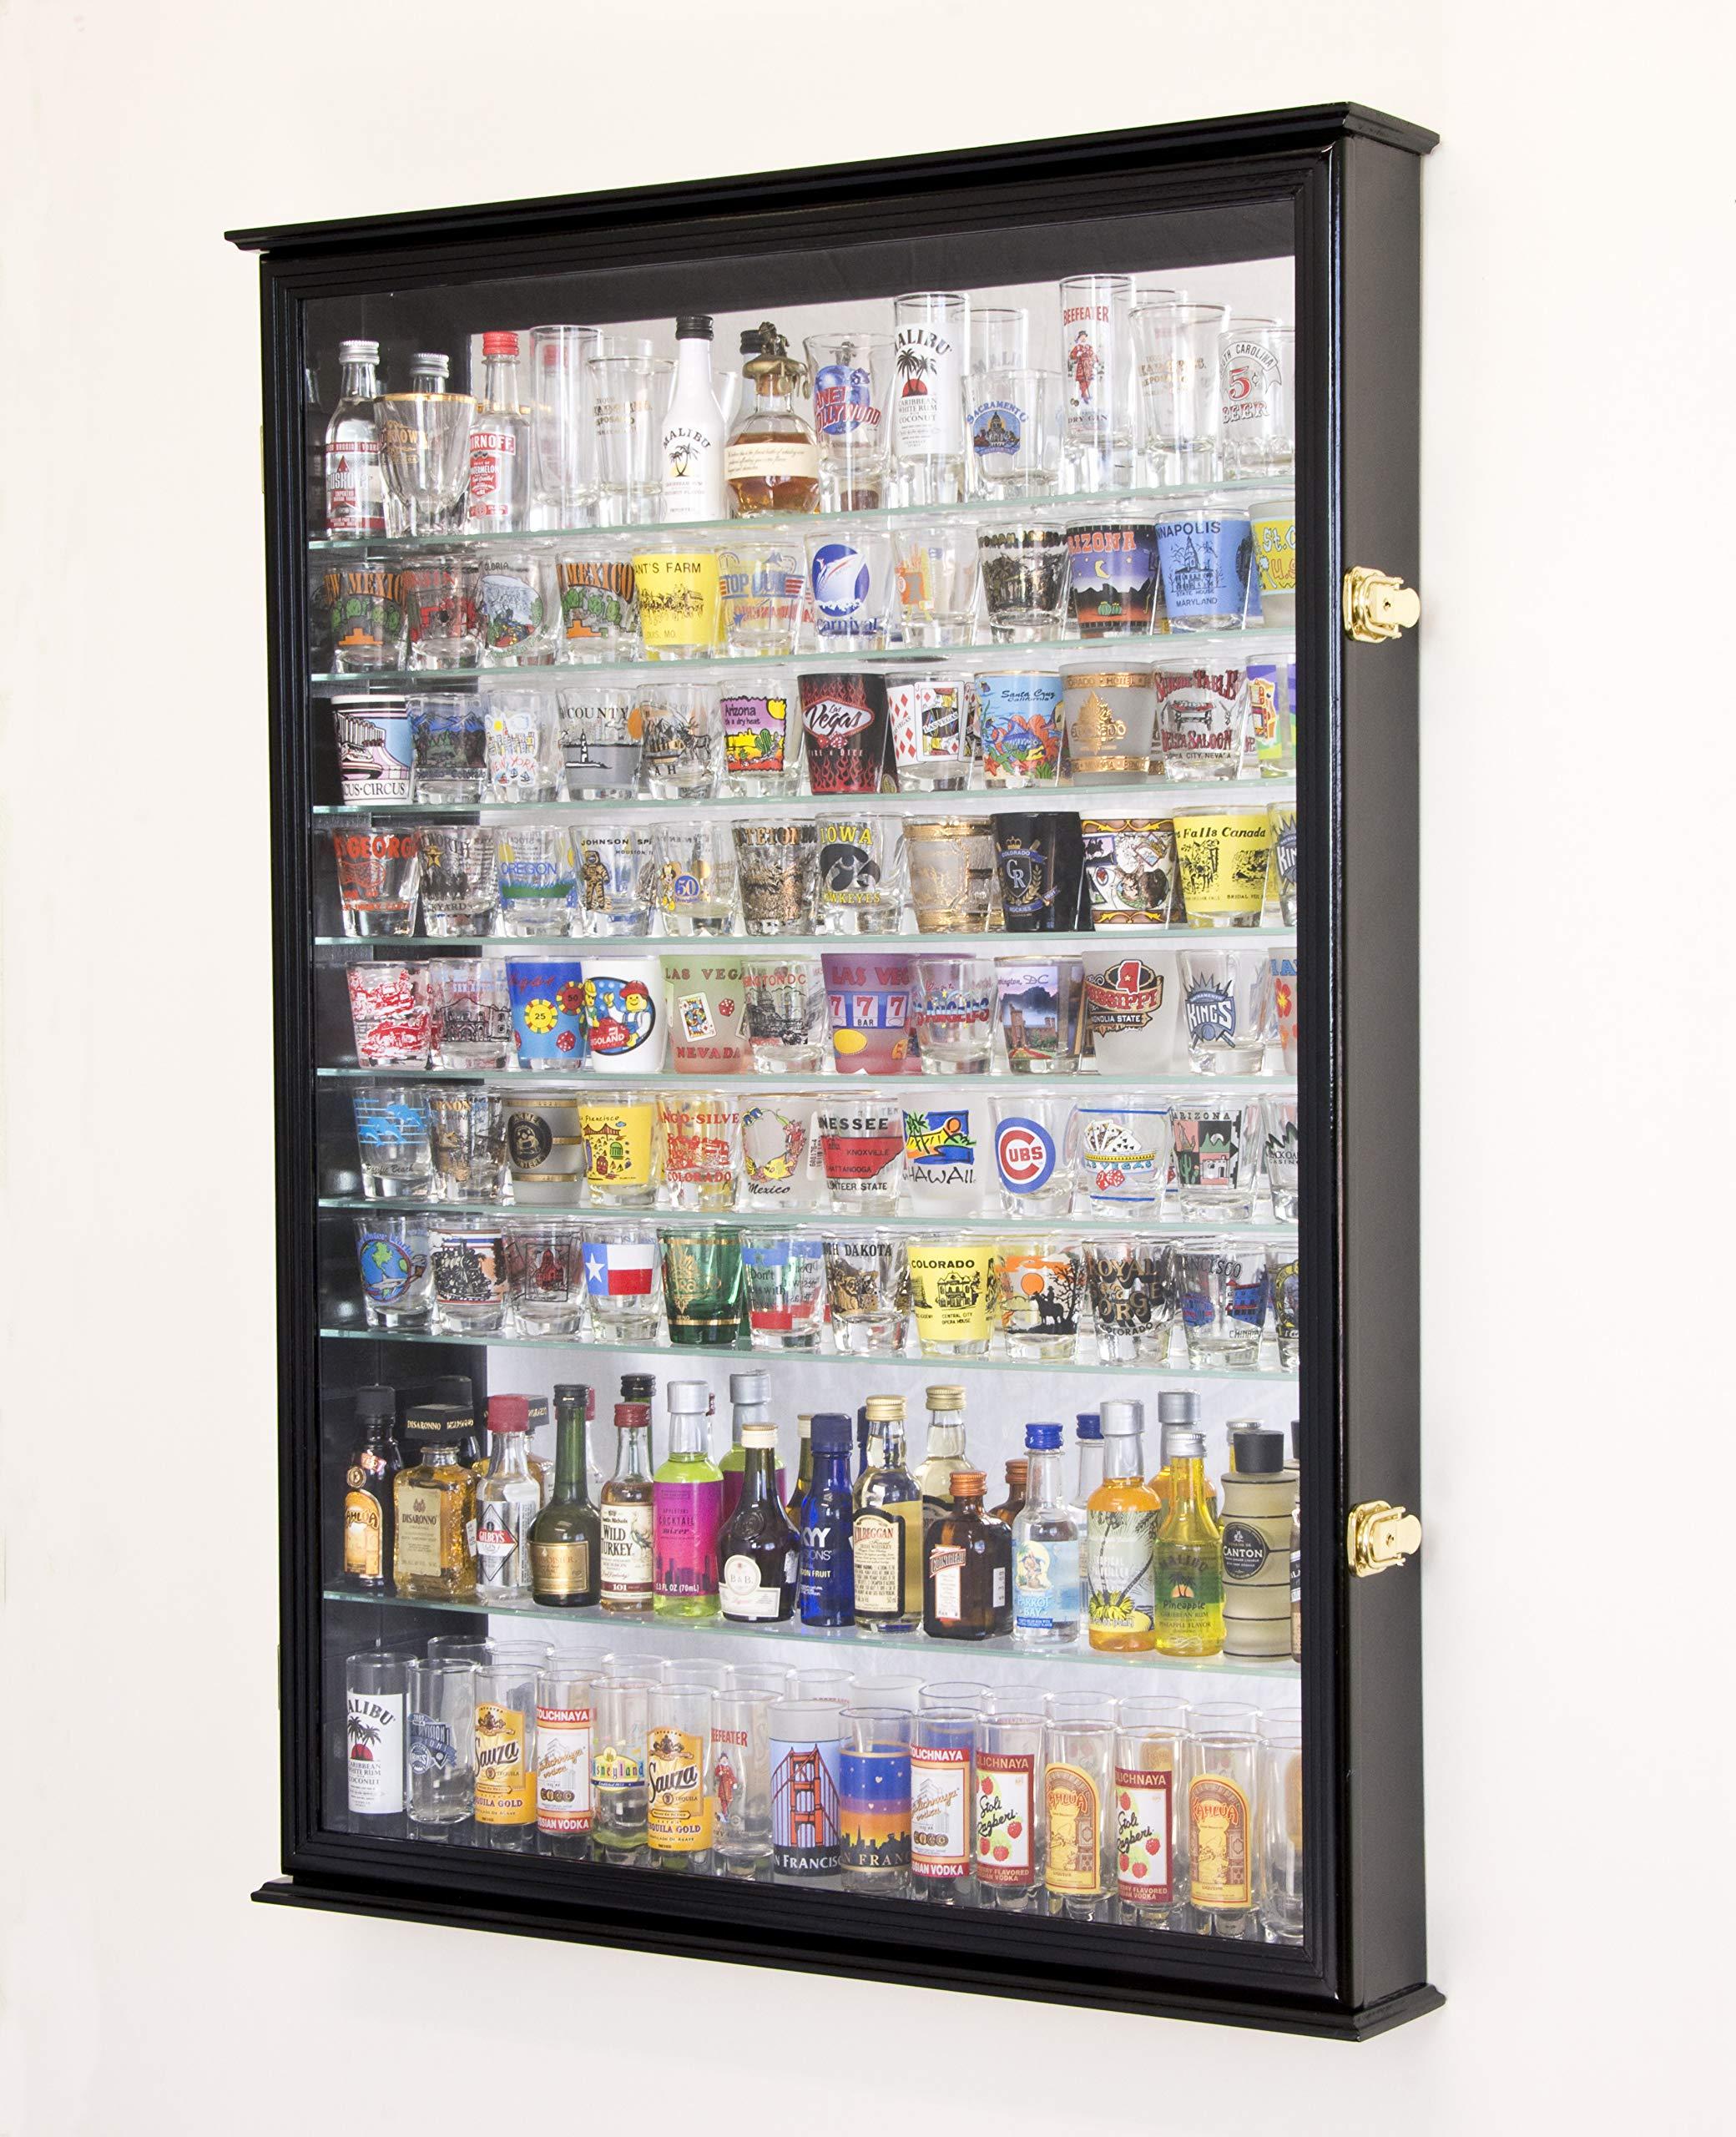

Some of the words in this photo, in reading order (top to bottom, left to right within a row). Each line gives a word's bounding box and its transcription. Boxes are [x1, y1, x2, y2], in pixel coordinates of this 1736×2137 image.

[1063, 306, 1108, 326] BEEFEAER
[1235, 344, 1275, 367] CAROLINA
[816, 386, 850, 410] ANET
[967, 401, 1027, 424] SACRAMENTO
[1223, 401, 1269, 423] BEER
[815, 405, 881, 434] OLLYWOOD
[664, 428, 711, 449] MALIBU
[667, 563, 702, 574] FARM
[1176, 597, 1218, 608] MARYLAND
[817, 617, 877, 634] Carnival
[1194, 669, 1239, 701] TABLE
[1002, 690, 1029, 699] Santa
[1033, 688, 1056, 699] Cruz
[568, 708, 628, 719] COUNTY
[725, 705, 756, 716] Arizona
[829, 704, 841, 713] Las
[805, 704, 862, 735] Vegas
[936, 711, 959, 728] VEGAS
[1188, 730, 1233, 750] SALOON
[510, 755, 536, 772] YORK
[820, 825, 873, 846] IOWA
[1183, 827, 1218, 839] Falls
[1221, 826, 1266, 838] Canada
[581, 838, 629, 846] JOHNSON
[1002, 850, 1031, 858] COLORADO
[501, 861, 558, 876] OREGON
[676, 878, 696, 897] 50
[665, 967, 691, 981] LAS
[831, 967, 866, 987] LAS
[1022, 974, 1049, 985] DC
[830, 996, 842, 1017] 7
[856, 996, 874, 1017] 7
[890, 996, 905, 1017] 7
[857, 1018, 874, 1027] BAR
[1117, 1015, 1141, 1023] STATE
[1187, 1001, 1232, 1033] KINGS
[677, 1046, 741, 1059] NEVADA
[1173, 1112, 1230, 1120] ARIZONA
[391, 1164, 414, 1173] Beach
[1103, 1160, 1152, 1170] VEGAS
[668, 1171, 732, 1182] COLORADO
[908, 1166, 974, 1185] HAWAII
[748, 1182, 790, 1195] Mexico
[861, 1182, 887, 1191] STATE
[845, 1244, 892, 1257] DAKOTA
[911, 1260, 975, 1269] COLORADO
[751, 1269, 775, 1281] Don't
[1100, 1322, 1153, 1336] COLORADO
[406, 1420, 442, 1431] DISARONNO
[402, 1513, 437, 1525] DISARONNO
[659, 1517, 695, 1527] COCKTAIL
[479, 1531, 505, 1543] GILBEY'S
[603, 1524, 626, 1541] WILD
[601, 1538, 633, 1556] TURKEY
[1223, 1546, 1263, 1558] CANTON
[730, 1574, 736, 1583] B
[679, 1584, 699, 1593] (70mL)
[1017, 1594, 1050, 1608] PARROT
[1163, 1600, 1206, 1610] Pineapple
[1024, 1607, 1042, 1616] BAY
[475, 1737, 519, 1777] Sauza
[591, 1760, 644, 1780] isneyland
[648, 1762, 698, 1803] Sauza
[498, 1800, 523, 1808] GOLD
[980, 1794, 1002, 1819] Stoli
[558, 1818, 589, 1830] VODKA
[1118, 1811, 1138, 1832] Stoli
[676, 1824, 701, 1834] GOLD
[931, 1864, 963, 1876] VODKA
[1133, 1886, 1168, 1894] FLAVORED
